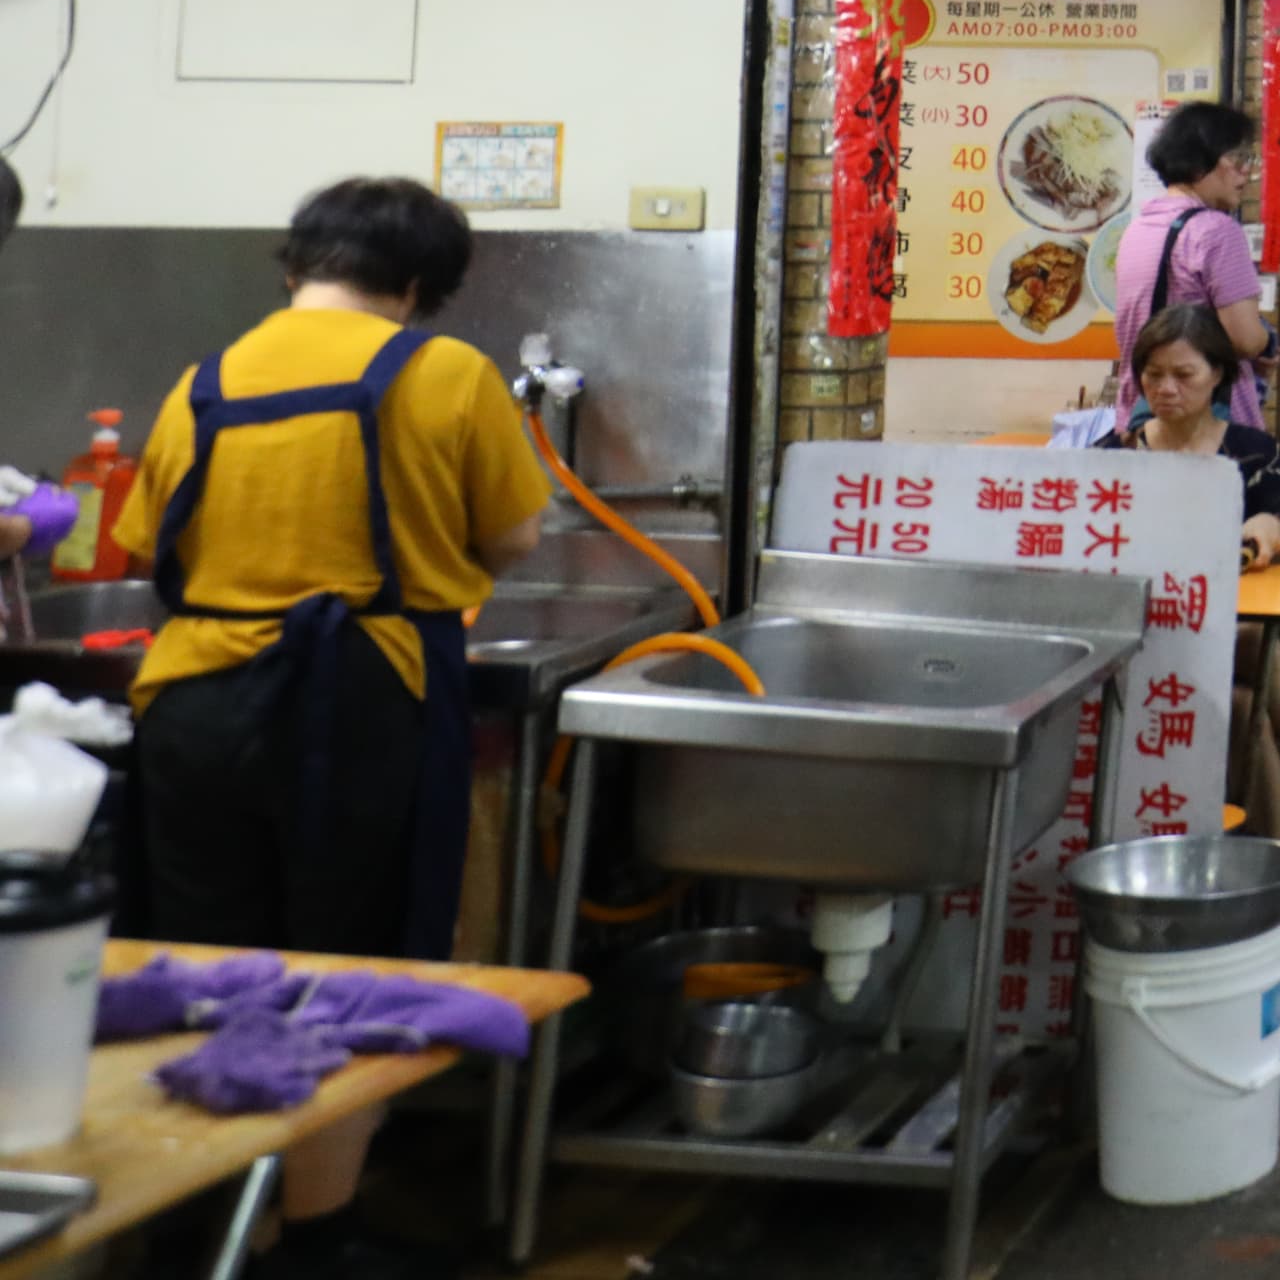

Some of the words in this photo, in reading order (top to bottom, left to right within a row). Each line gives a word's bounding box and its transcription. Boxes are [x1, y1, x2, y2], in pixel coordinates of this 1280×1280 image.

[946, 0, 1056, 19] 每星期一公休
[1066, 1, 1138, 20] 營業時間
[946, 22, 1138, 39] AM07:00-PM03:00
[957, 63, 990, 85] 50
[954, 105, 988, 127] 30
[952, 148, 987, 171] 40
[951, 190, 985, 214] 40
[950, 232, 984, 256] 30
[949, 275, 982, 299] 30
[976, 476, 1133, 515] 米粉湯
[1015, 522, 1131, 558] 大腸
